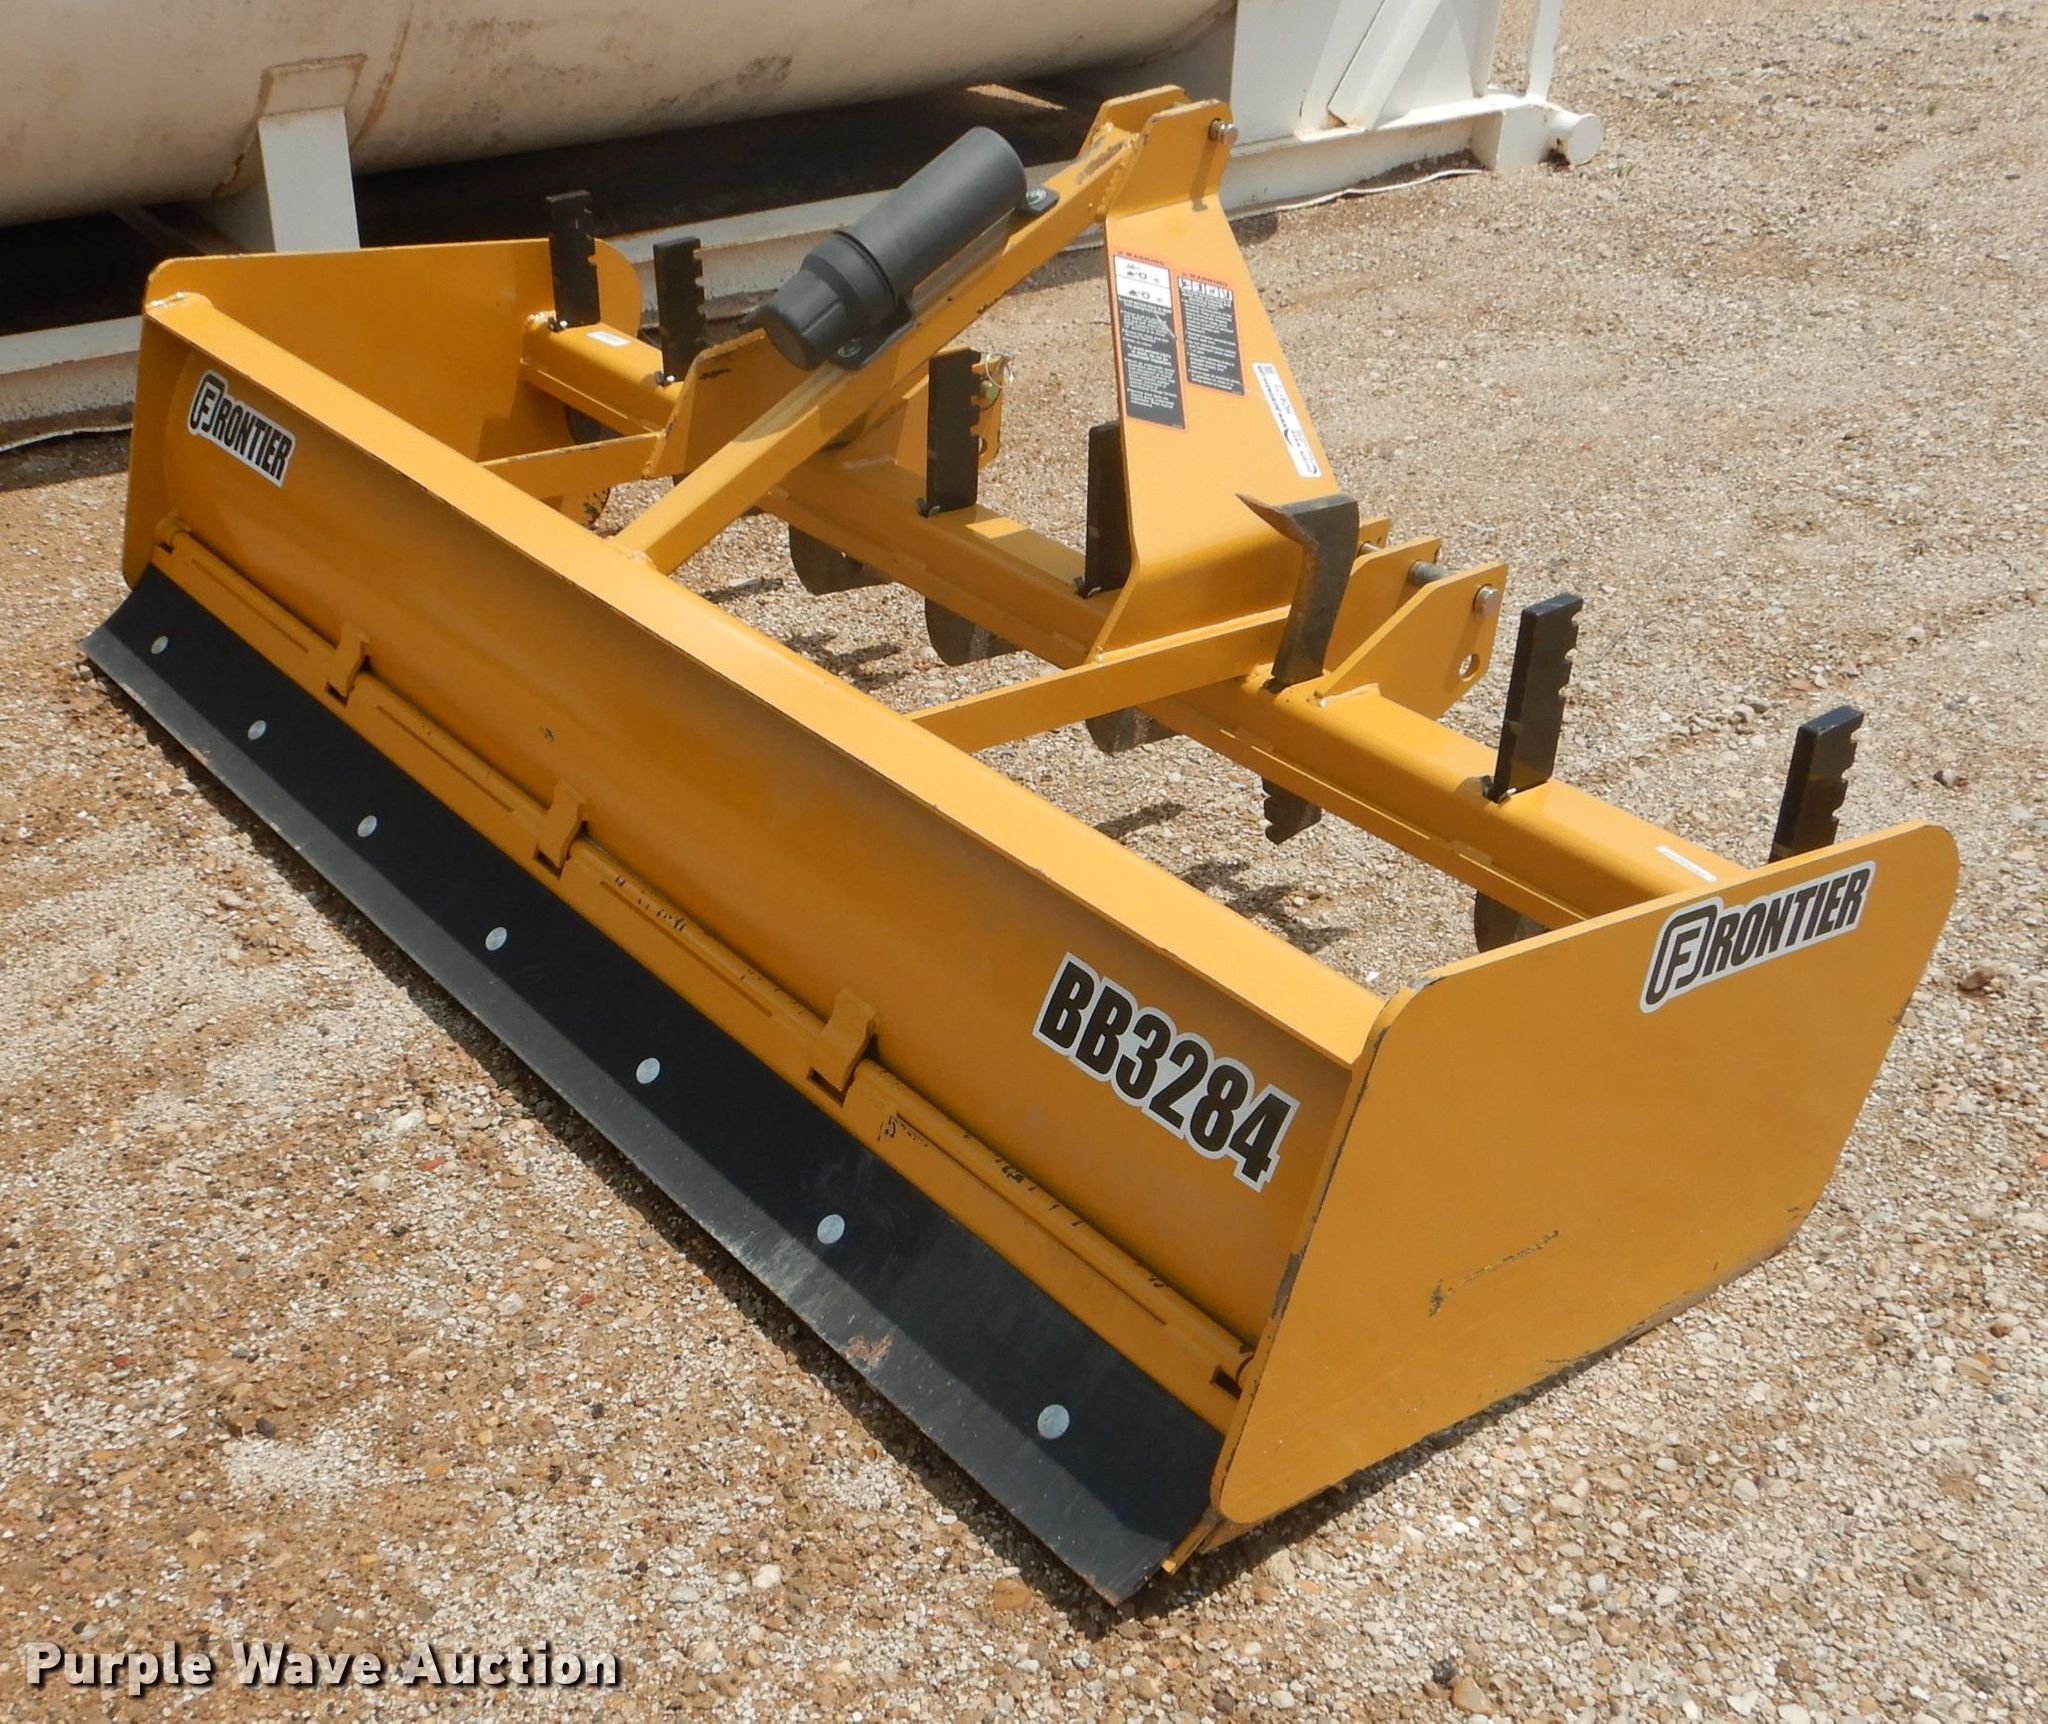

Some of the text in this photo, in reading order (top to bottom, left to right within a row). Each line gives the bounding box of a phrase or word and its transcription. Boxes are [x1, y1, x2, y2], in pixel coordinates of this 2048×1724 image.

[189, 373, 294, 482] FRONTIER
[1645, 867, 1872, 1006] FRONTIER
[1038, 960, 1292, 1183] BB3284
